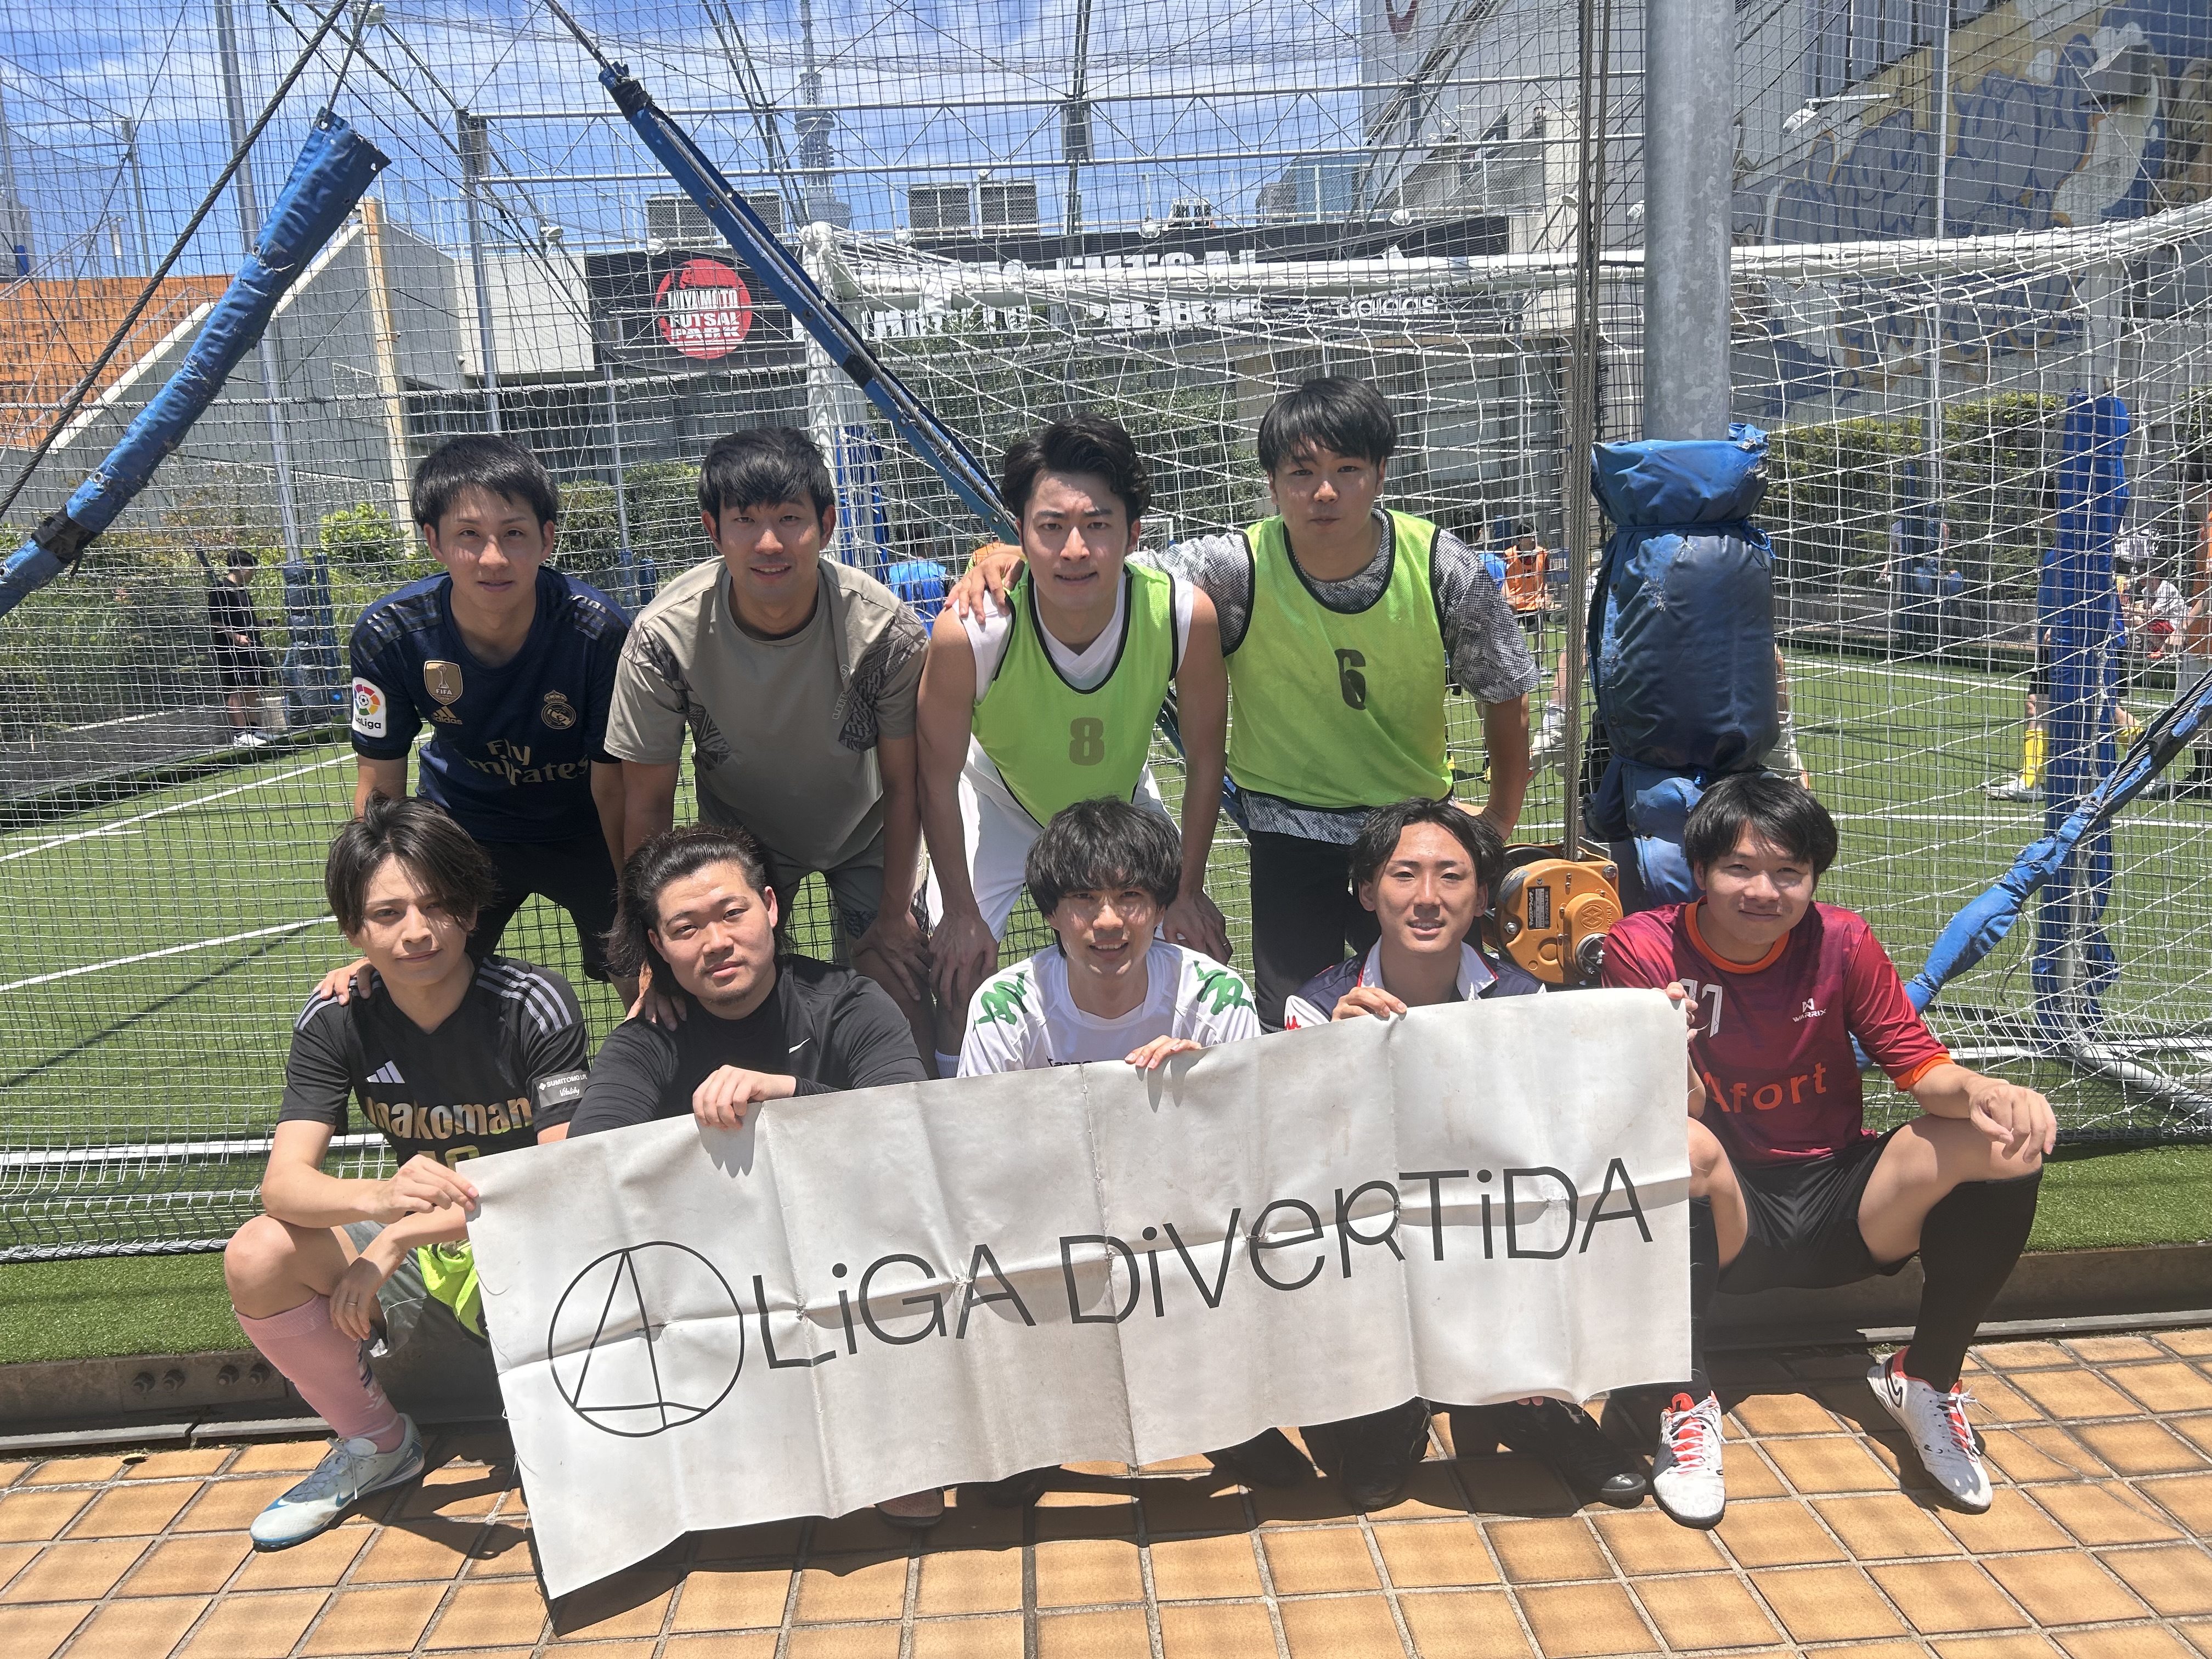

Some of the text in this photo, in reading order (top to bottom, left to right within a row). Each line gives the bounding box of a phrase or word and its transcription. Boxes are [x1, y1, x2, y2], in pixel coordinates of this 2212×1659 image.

[669, 312, 740, 328] FUTSAL
[670, 326, 741, 340] PARK
[1334, 648, 1366, 710] 6
[356, 714, 381, 730] LaLiga
[431, 714, 463, 725] adidas
[1069, 718, 1105, 766] 8
[486, 739, 531, 766] Fly
[1792, 1008, 1826, 1022] WARRIX
[546, 1075, 580, 1087] SUMITOMO
[559, 1086, 580, 1097] Vitality
